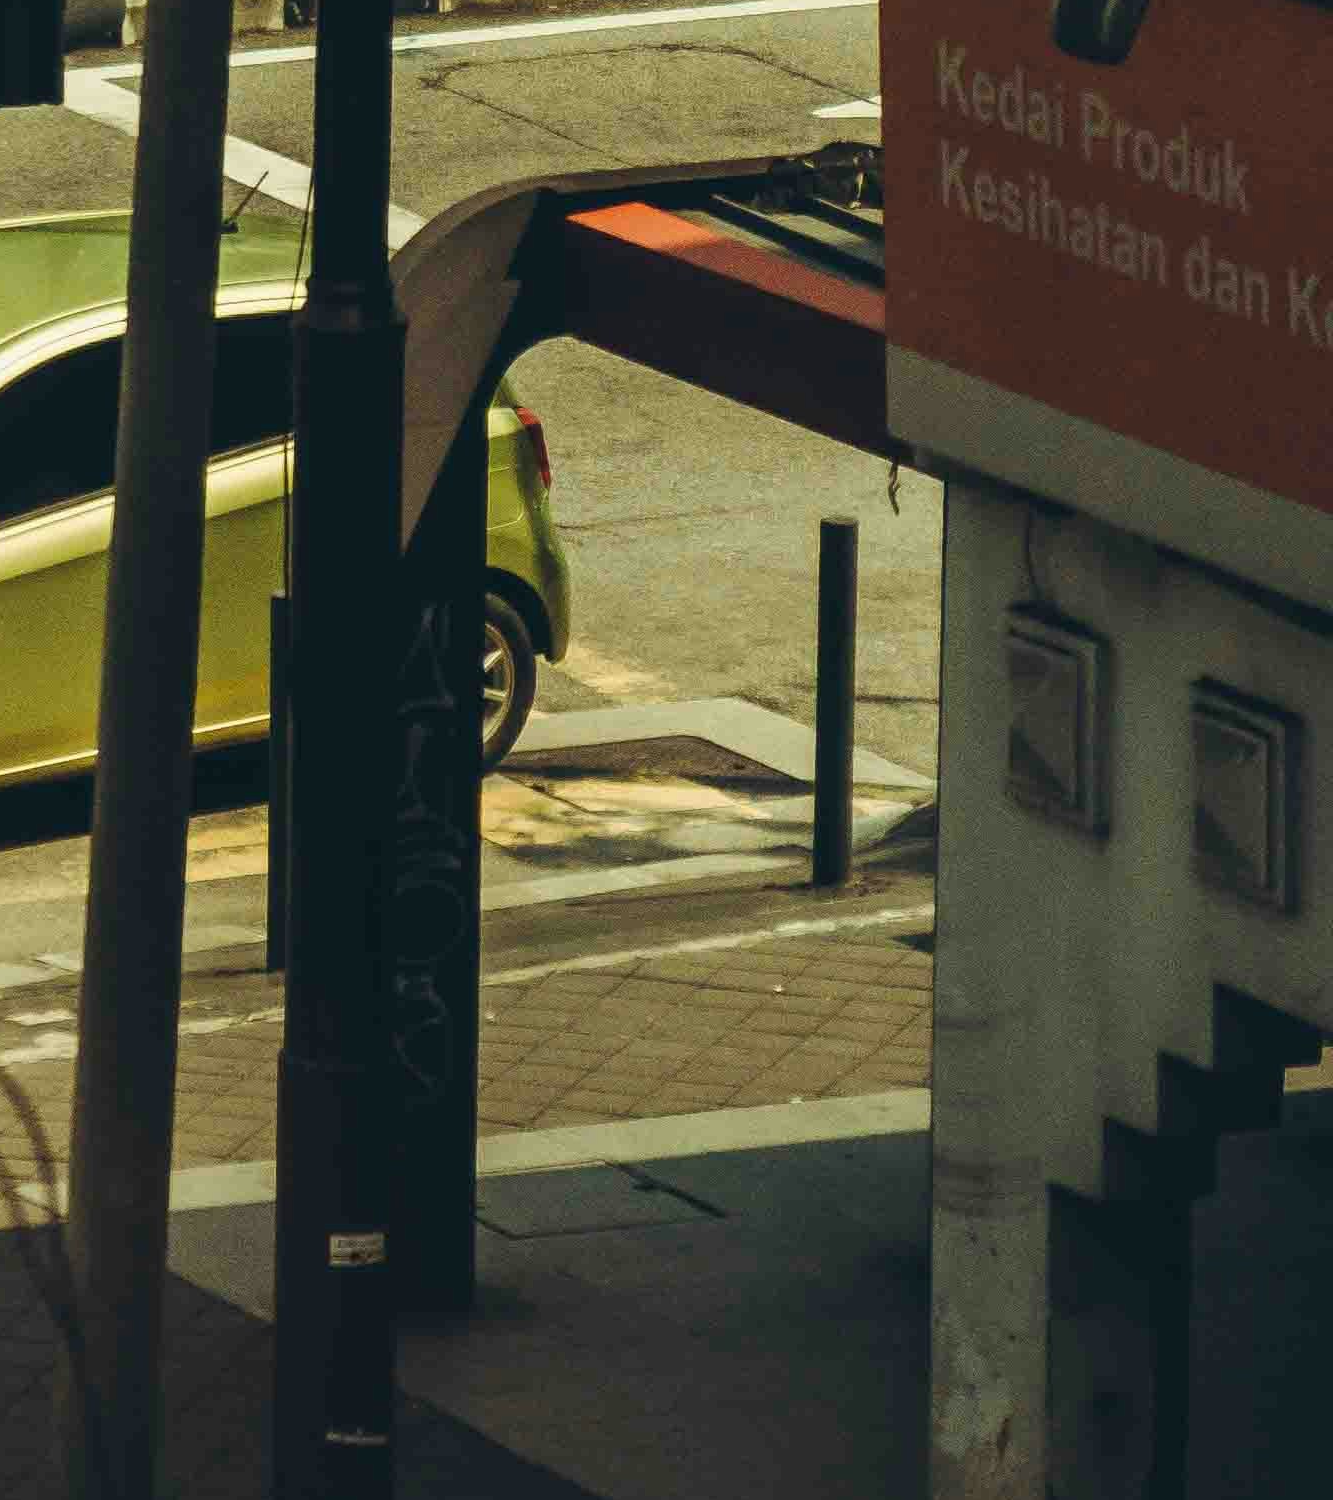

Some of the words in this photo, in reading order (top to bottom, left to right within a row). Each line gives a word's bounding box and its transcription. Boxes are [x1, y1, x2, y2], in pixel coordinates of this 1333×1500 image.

[937, 38, 1065, 152] Kedai
[1081, 87, 1251, 217] Produk
[939, 137, 1167, 286] Kesihatan
[1185, 234, 1270, 327] dan
